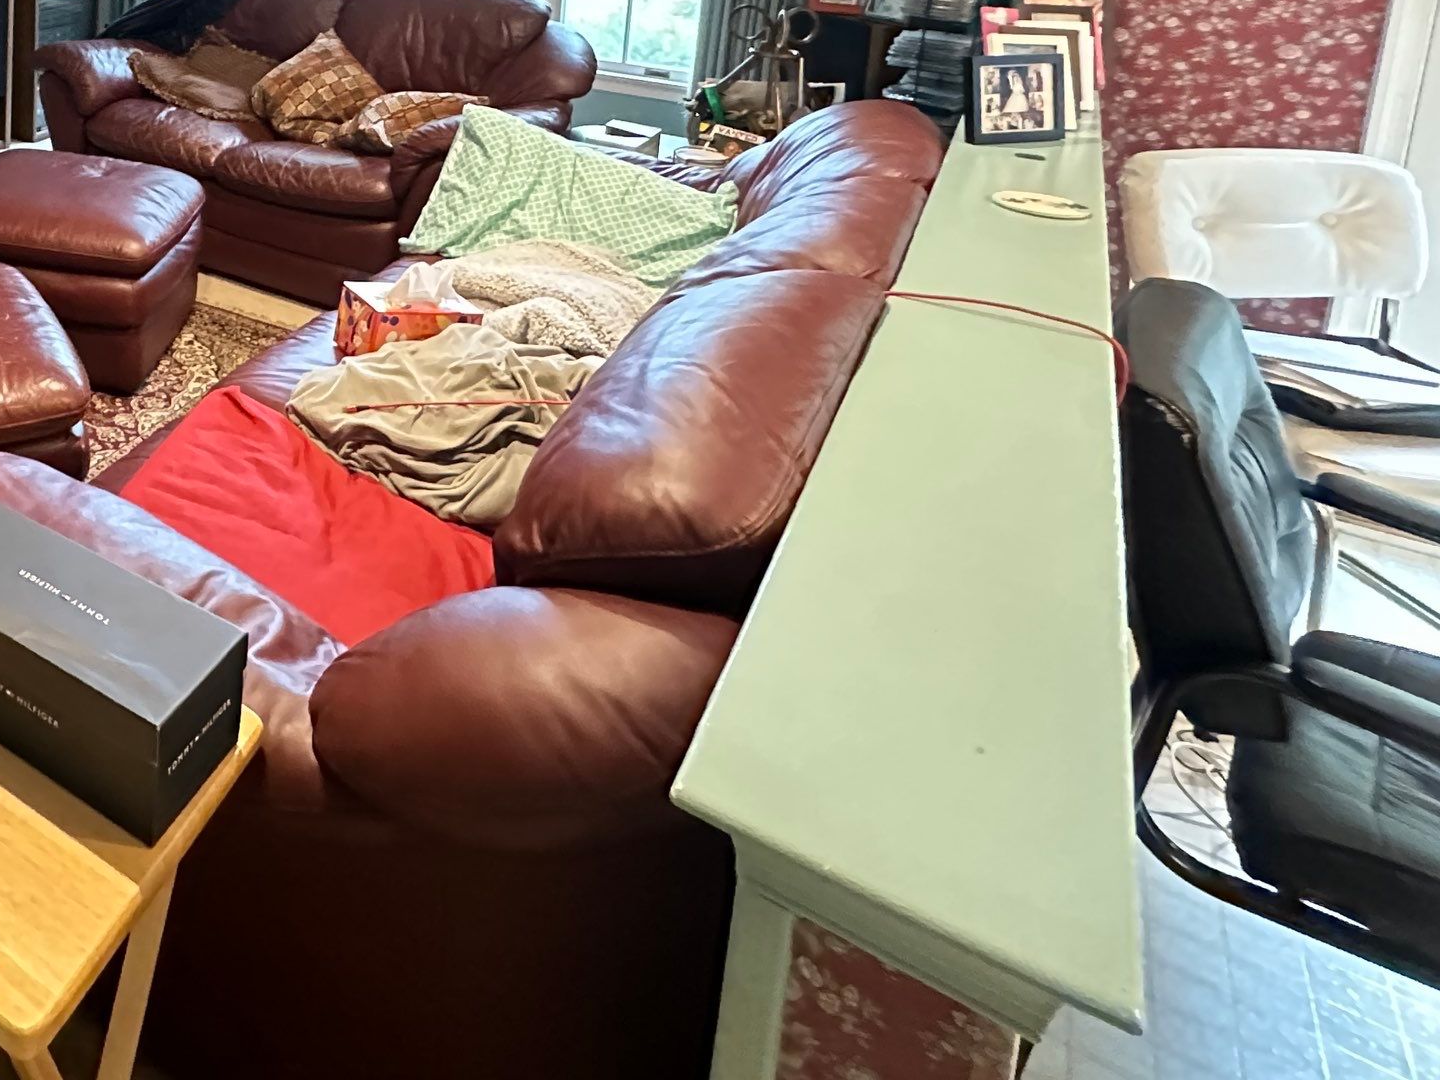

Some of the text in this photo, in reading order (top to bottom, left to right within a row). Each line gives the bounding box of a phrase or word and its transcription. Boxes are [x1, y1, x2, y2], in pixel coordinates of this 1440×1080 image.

[18, 569, 110, 625] TOMMY HILFIGER
[16, 695, 59, 728] HILFIGER
[167, 740, 194, 776] TOMMY
